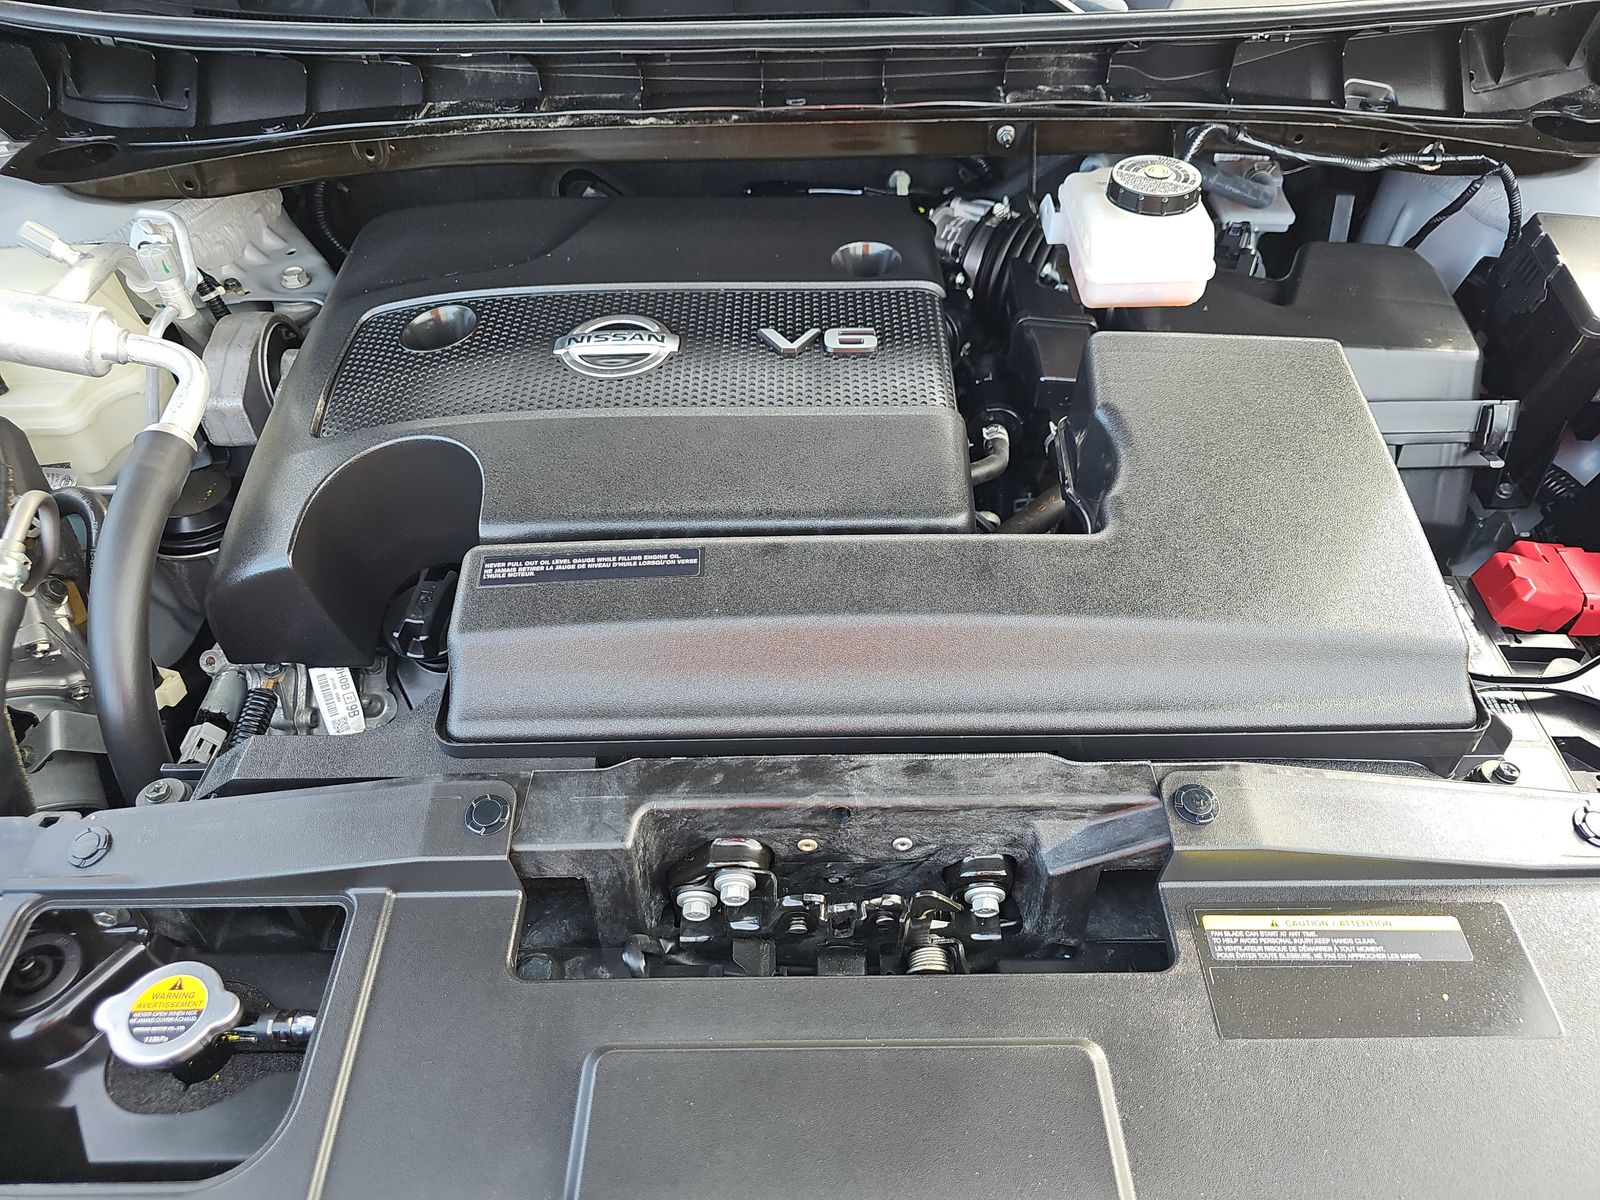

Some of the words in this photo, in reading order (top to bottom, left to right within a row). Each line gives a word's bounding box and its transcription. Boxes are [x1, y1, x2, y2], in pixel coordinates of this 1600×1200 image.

[566, 332, 666, 346] NISSAN
[756, 327, 878, 359] V6
[152, 992, 196, 1000] WARNING
[137, 1000, 204, 1009] AVERTISSEMENT
